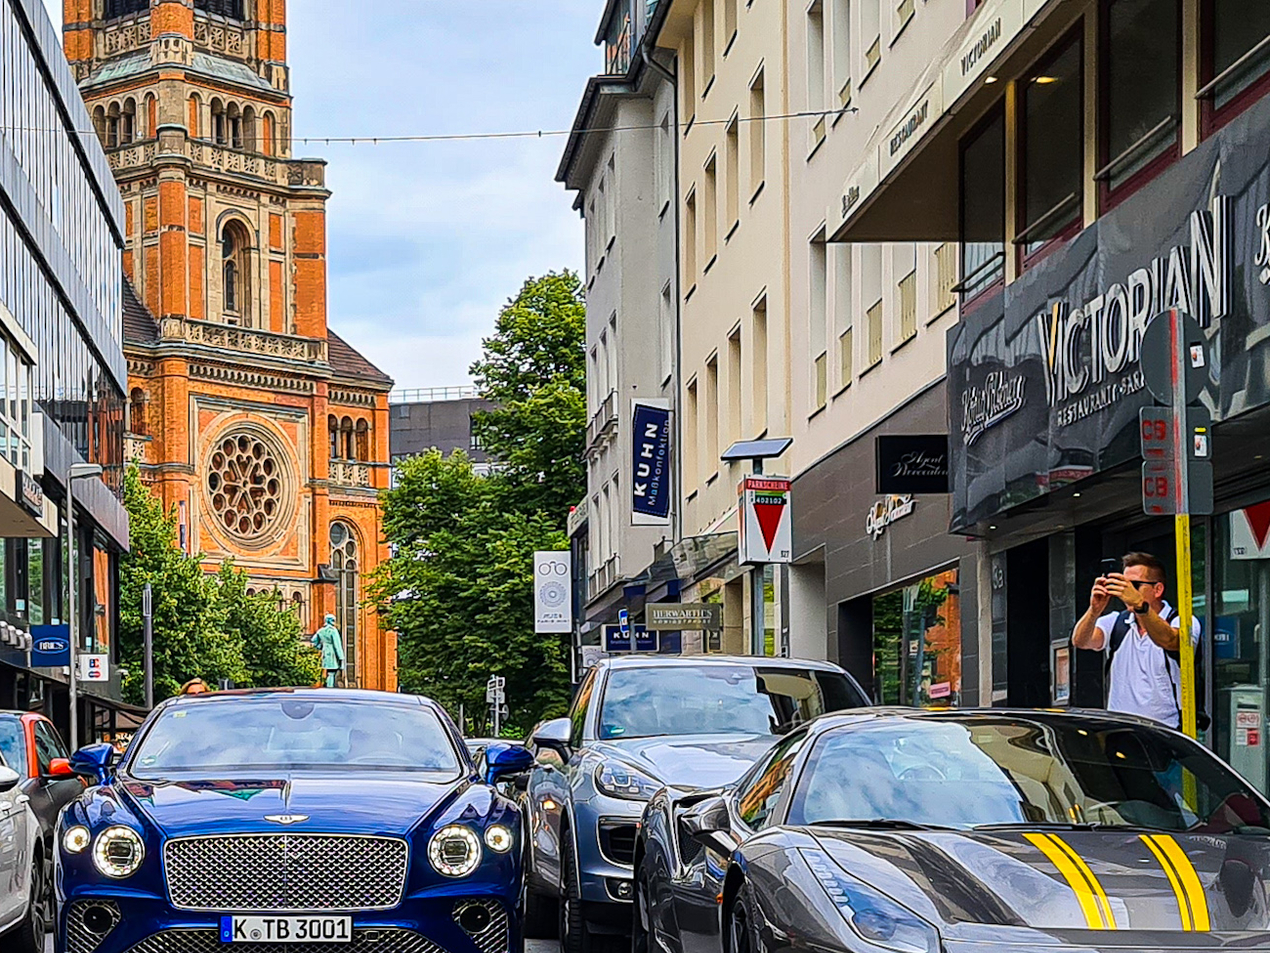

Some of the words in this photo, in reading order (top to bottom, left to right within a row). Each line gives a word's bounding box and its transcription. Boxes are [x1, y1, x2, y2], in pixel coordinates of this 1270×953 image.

[960, 17, 1001, 76] VICTORIAN
[1037, 194, 1227, 407] VICTORIAN
[634, 423, 658, 496] KUHN
[234, 919, 247, 939] K
[263, 919, 290, 939] TB
[295, 919, 349, 939] 3001
